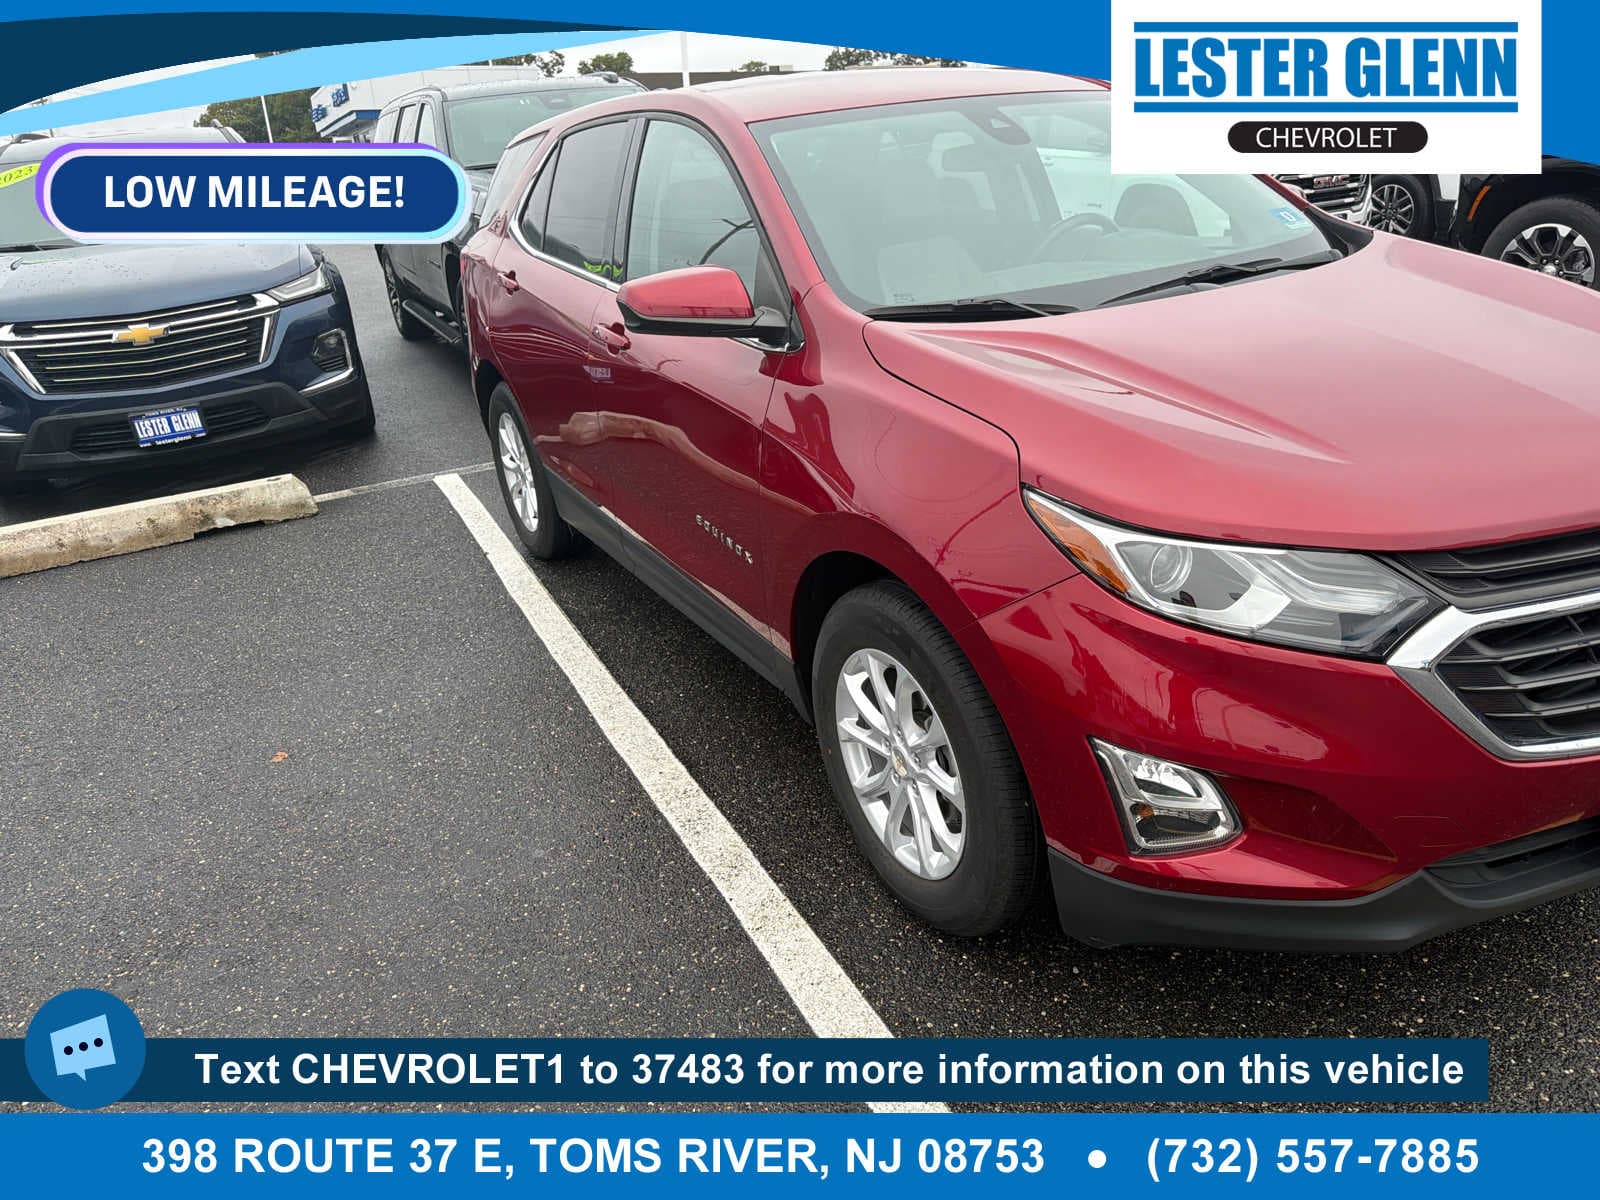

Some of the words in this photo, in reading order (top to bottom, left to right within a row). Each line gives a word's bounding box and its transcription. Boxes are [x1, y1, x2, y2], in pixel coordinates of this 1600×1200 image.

[134, 417, 172, 438] LESTER
[171, 411, 203, 432] GLENN
[696, 514, 753, 565] EQUINOX
